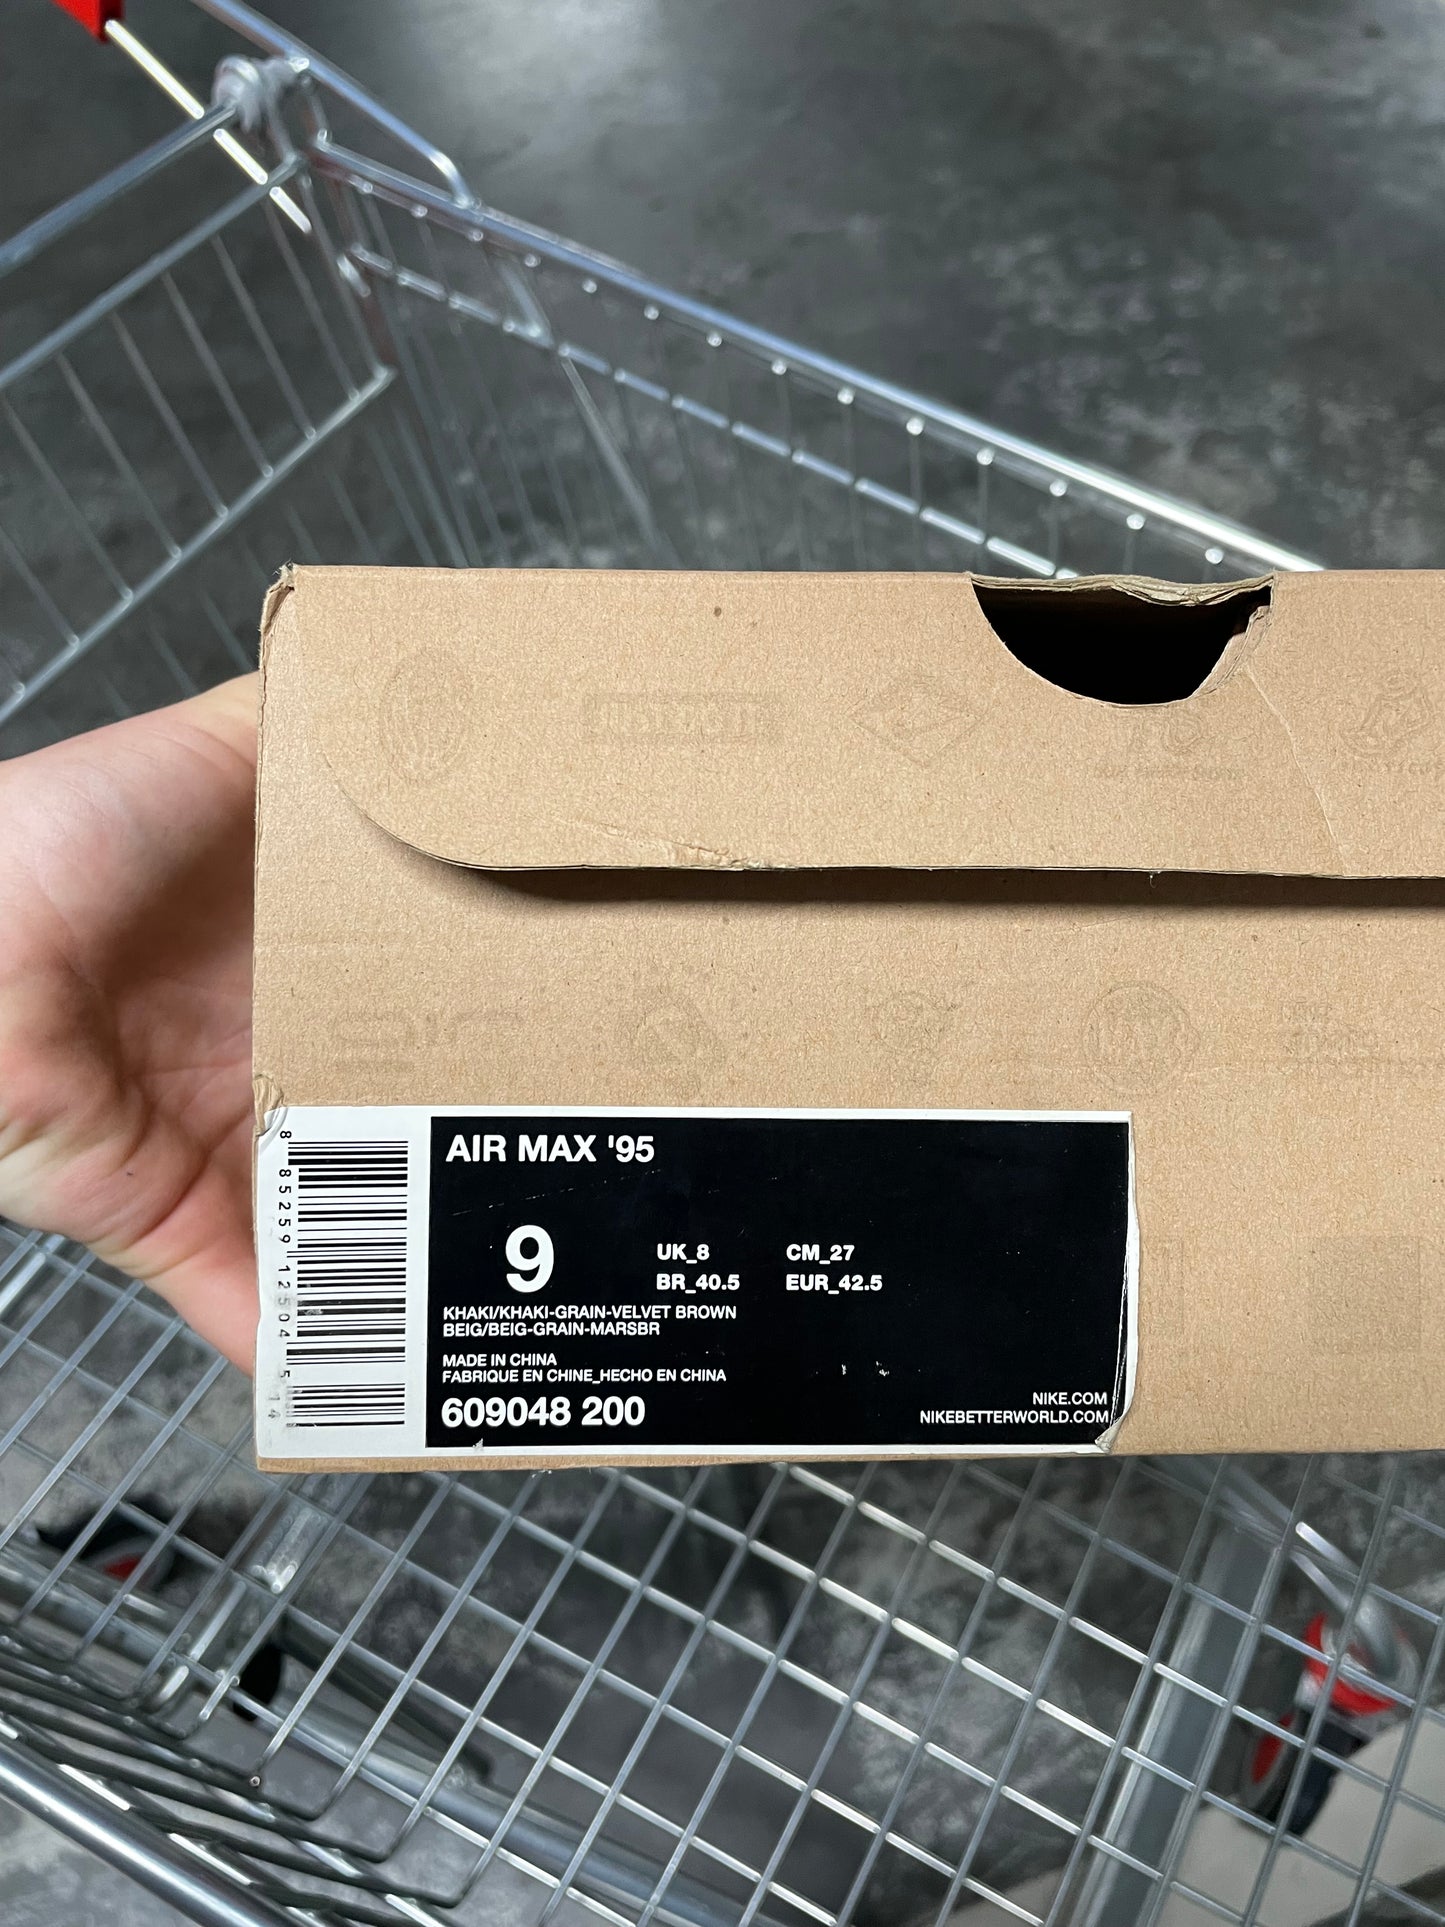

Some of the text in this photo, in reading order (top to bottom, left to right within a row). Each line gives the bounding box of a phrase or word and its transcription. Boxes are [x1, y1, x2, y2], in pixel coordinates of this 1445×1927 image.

[280, 1131, 292, 1139] 8
[446, 1135, 655, 1163] AIR MAX '95
[279, 1169, 292, 1243] 85259
[506, 1225, 554, 1293] 9
[656, 1243, 709, 1264] UK_8
[786, 1243, 855, 1265] CM_27
[656, 1273, 740, 1294] BR_40.5
[786, 1273, 883, 1295] EUR_42.5
[443, 1304, 737, 1321] KHAKI/KHAKI-GRAIN-VELVET BROWN
[443, 1321, 660, 1338] BEIG/BEIG-GRAIN-MARSBR
[443, 1353, 557, 1368] MADE IN CHINA
[279, 1370, 291, 1379] 5
[443, 1368, 727, 1384] FABRIQUE EN CHINE_HECHO EN CHINA
[1032, 1391, 1108, 1406] NIKE.COM
[441, 1395, 646, 1428] 609048 200
[919, 1409, 1109, 1424] NIKEBETTERWORLD.COM
